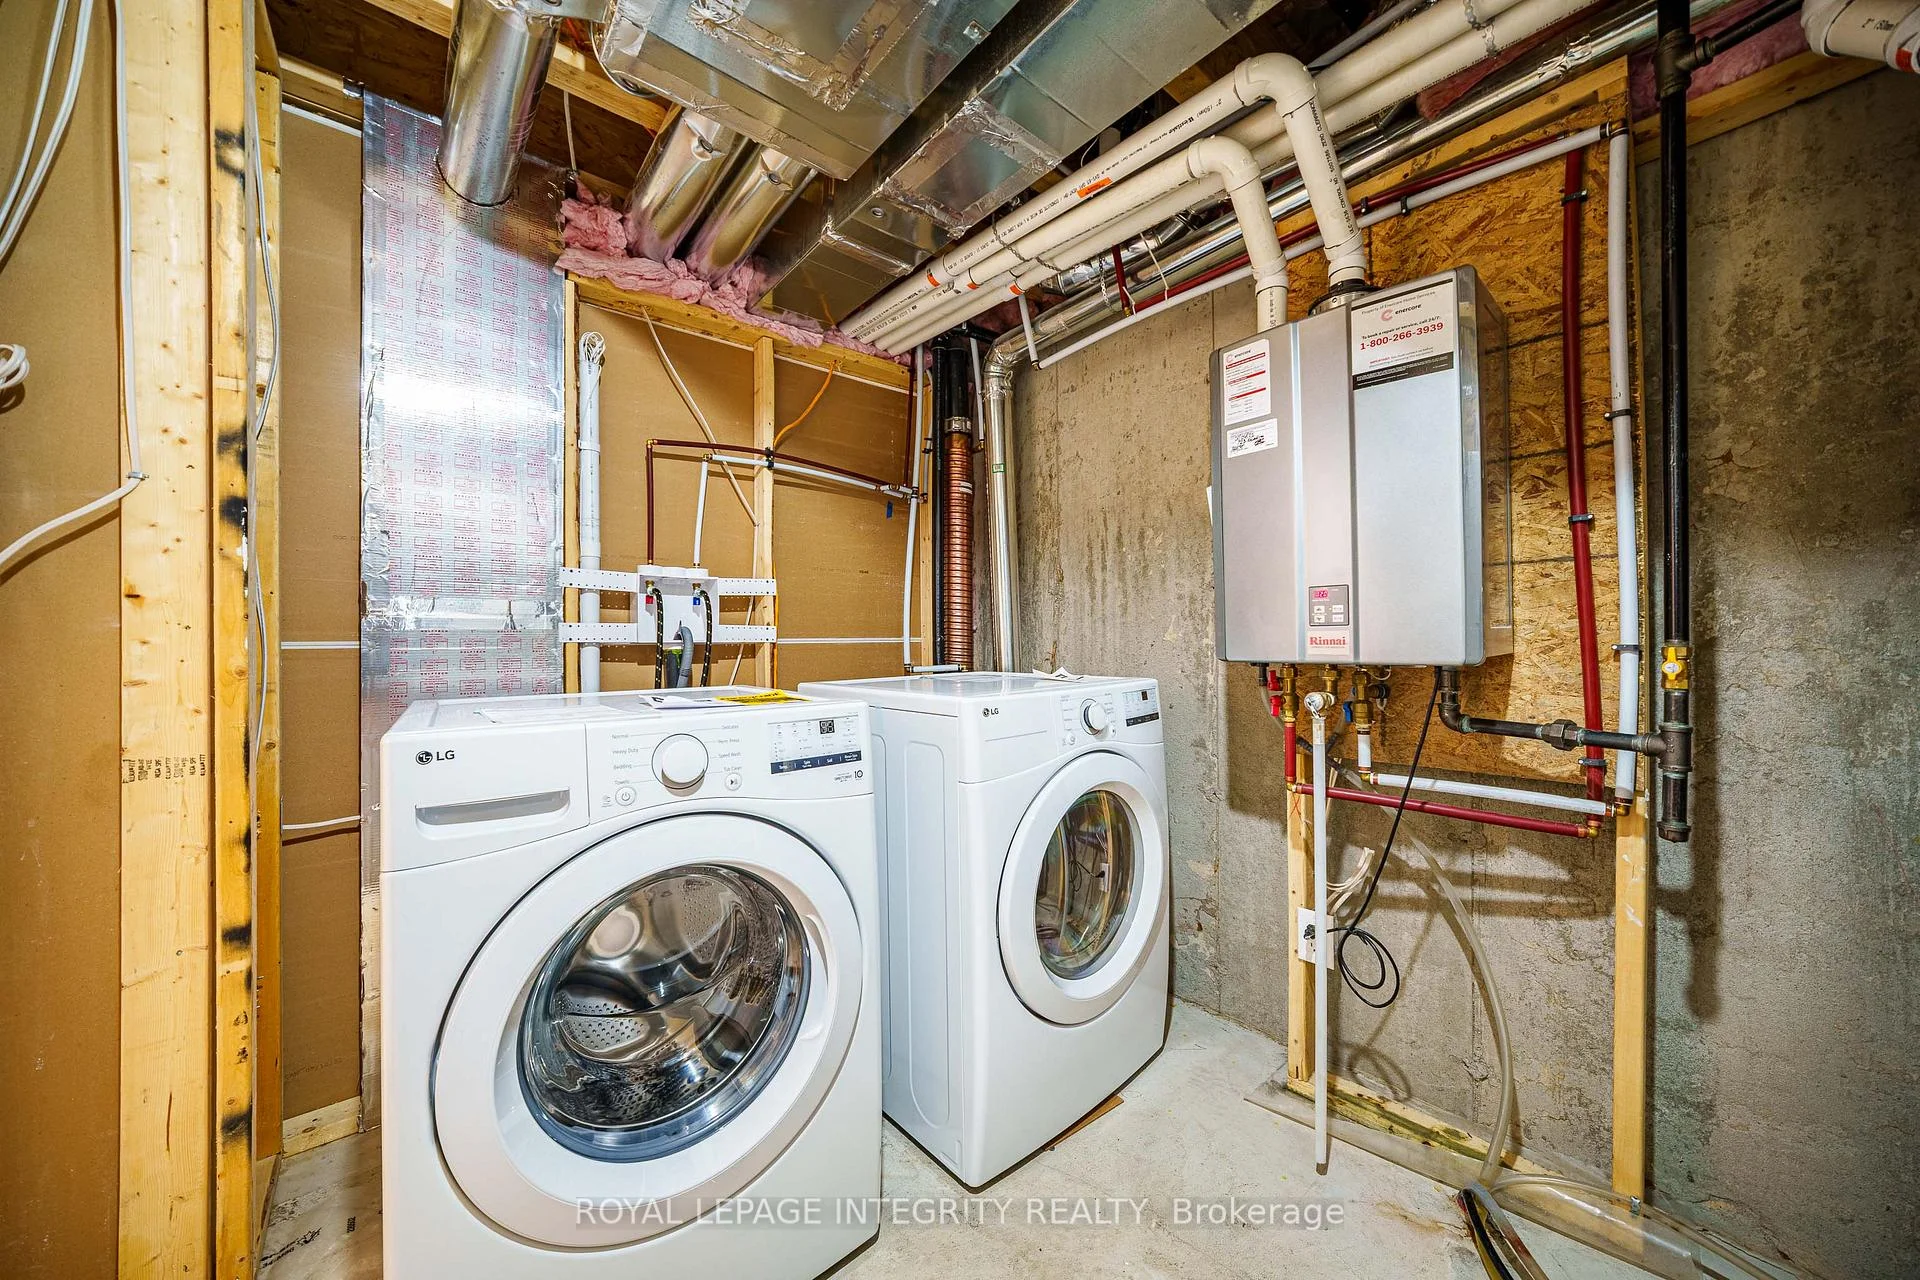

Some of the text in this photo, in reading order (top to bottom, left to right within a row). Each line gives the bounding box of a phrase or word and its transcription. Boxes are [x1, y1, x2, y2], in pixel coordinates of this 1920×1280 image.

[1319, 133, 1327, 147] ZERO
[1360, 322, 1444, 350] 1-800-266-3939
[1309, 636, 1346, 646] Rinnai
[990, 707, 999, 716] LG
[436, 750, 455, 760] LG
[854, 770, 863, 778] 10
